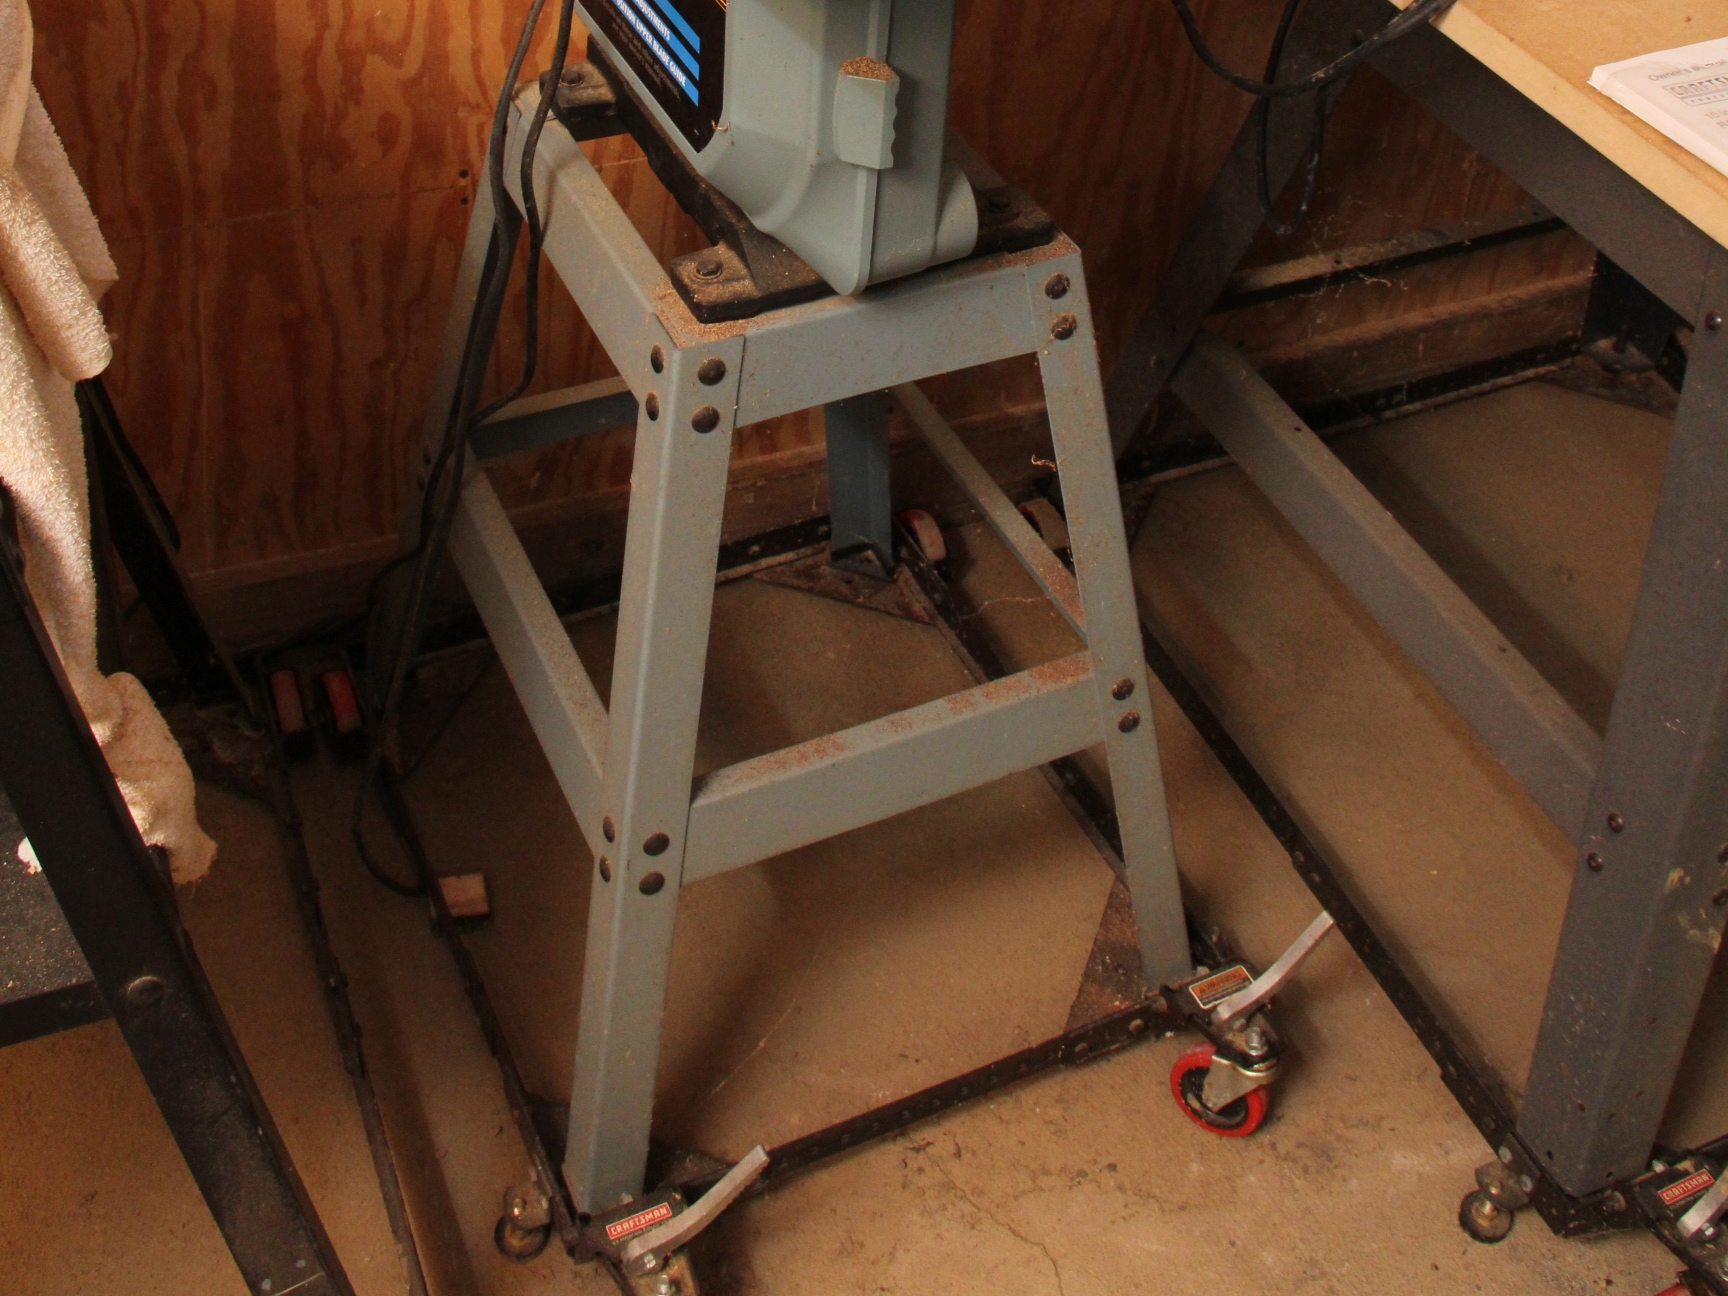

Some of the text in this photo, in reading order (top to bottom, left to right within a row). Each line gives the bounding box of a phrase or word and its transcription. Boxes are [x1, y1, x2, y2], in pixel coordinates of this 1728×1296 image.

[636, 20, 653, 45] UPPER
[652, 39, 670, 66] BLADE
[669, 61, 687, 87] GUIDE
[1662, 1173, 1710, 1201] CRAFTSMAN
[610, 1206, 668, 1235] CRAFTSMAN
